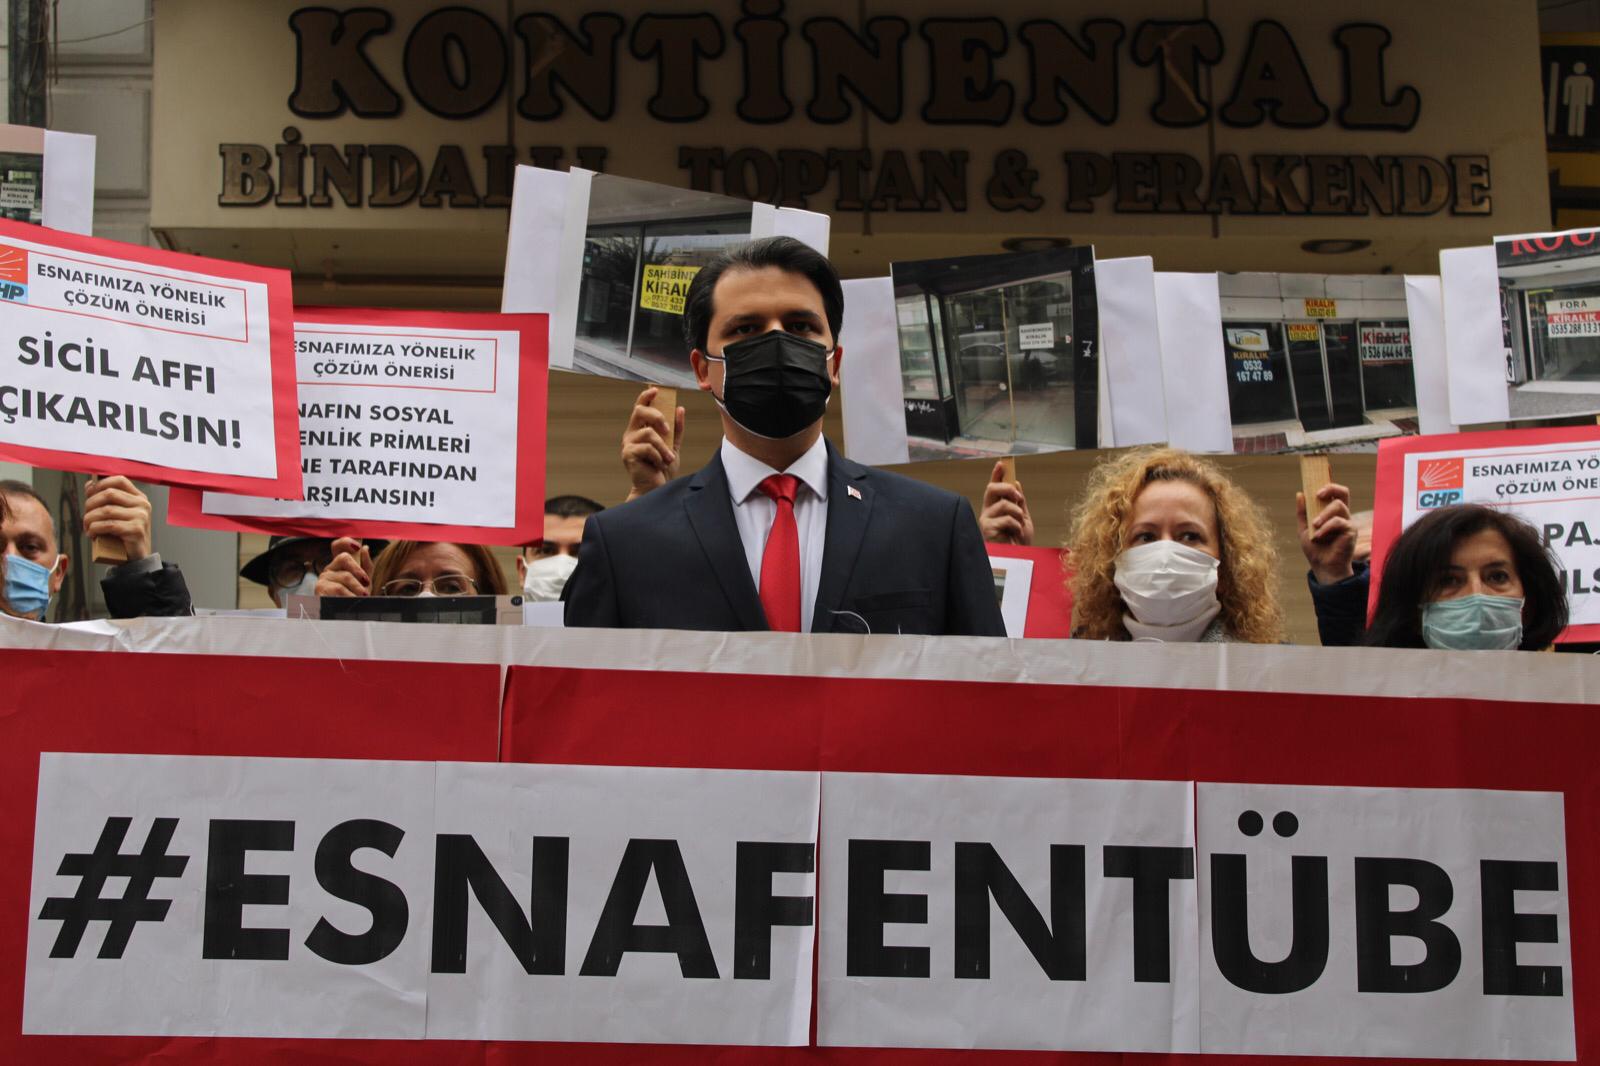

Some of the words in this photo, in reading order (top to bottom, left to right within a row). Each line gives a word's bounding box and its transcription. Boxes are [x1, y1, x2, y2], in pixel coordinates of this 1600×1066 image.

[287, 0, 1422, 132] KONTİNENTAL
[986, 149, 1045, 213] &
[1063, 151, 1493, 217] PERAKENDE
[37, 263, 145, 294] ESNAFIMIZA
[150, 283, 226, 308] YÖNELİK
[63, 289, 130, 312] ÇÖZÜM
[135, 303, 206, 326] ÖNERİSİ
[1559, 299, 1588, 310] FORA
[400, 342, 475, 360] YÖNELİK
[17, 331, 119, 378] SİCİL
[132, 356, 216, 394] AFFI
[313, 359, 378, 378] ÇÖZÜM
[384, 361, 455, 380] ÖNERİSİ
[0, 385, 241, 449] ÇIKARILSIN!
[370, 406, 453, 424] SOSYAL
[370, 430, 470, 453] PRİMLERİ
[330, 459, 476, 481] TARAFINDAN
[1473, 461, 1571, 476] ESNAFIMIZA
[275, 486, 435, 507] RŞILANSIN!
[1495, 479, 1557, 498] ÇÖZÜM
[1562, 476, 1600, 491] ÖNE
[1420, 492, 1460, 508] CHP
[38, 810, 1564, 997] #ESNAFENTÜBE
